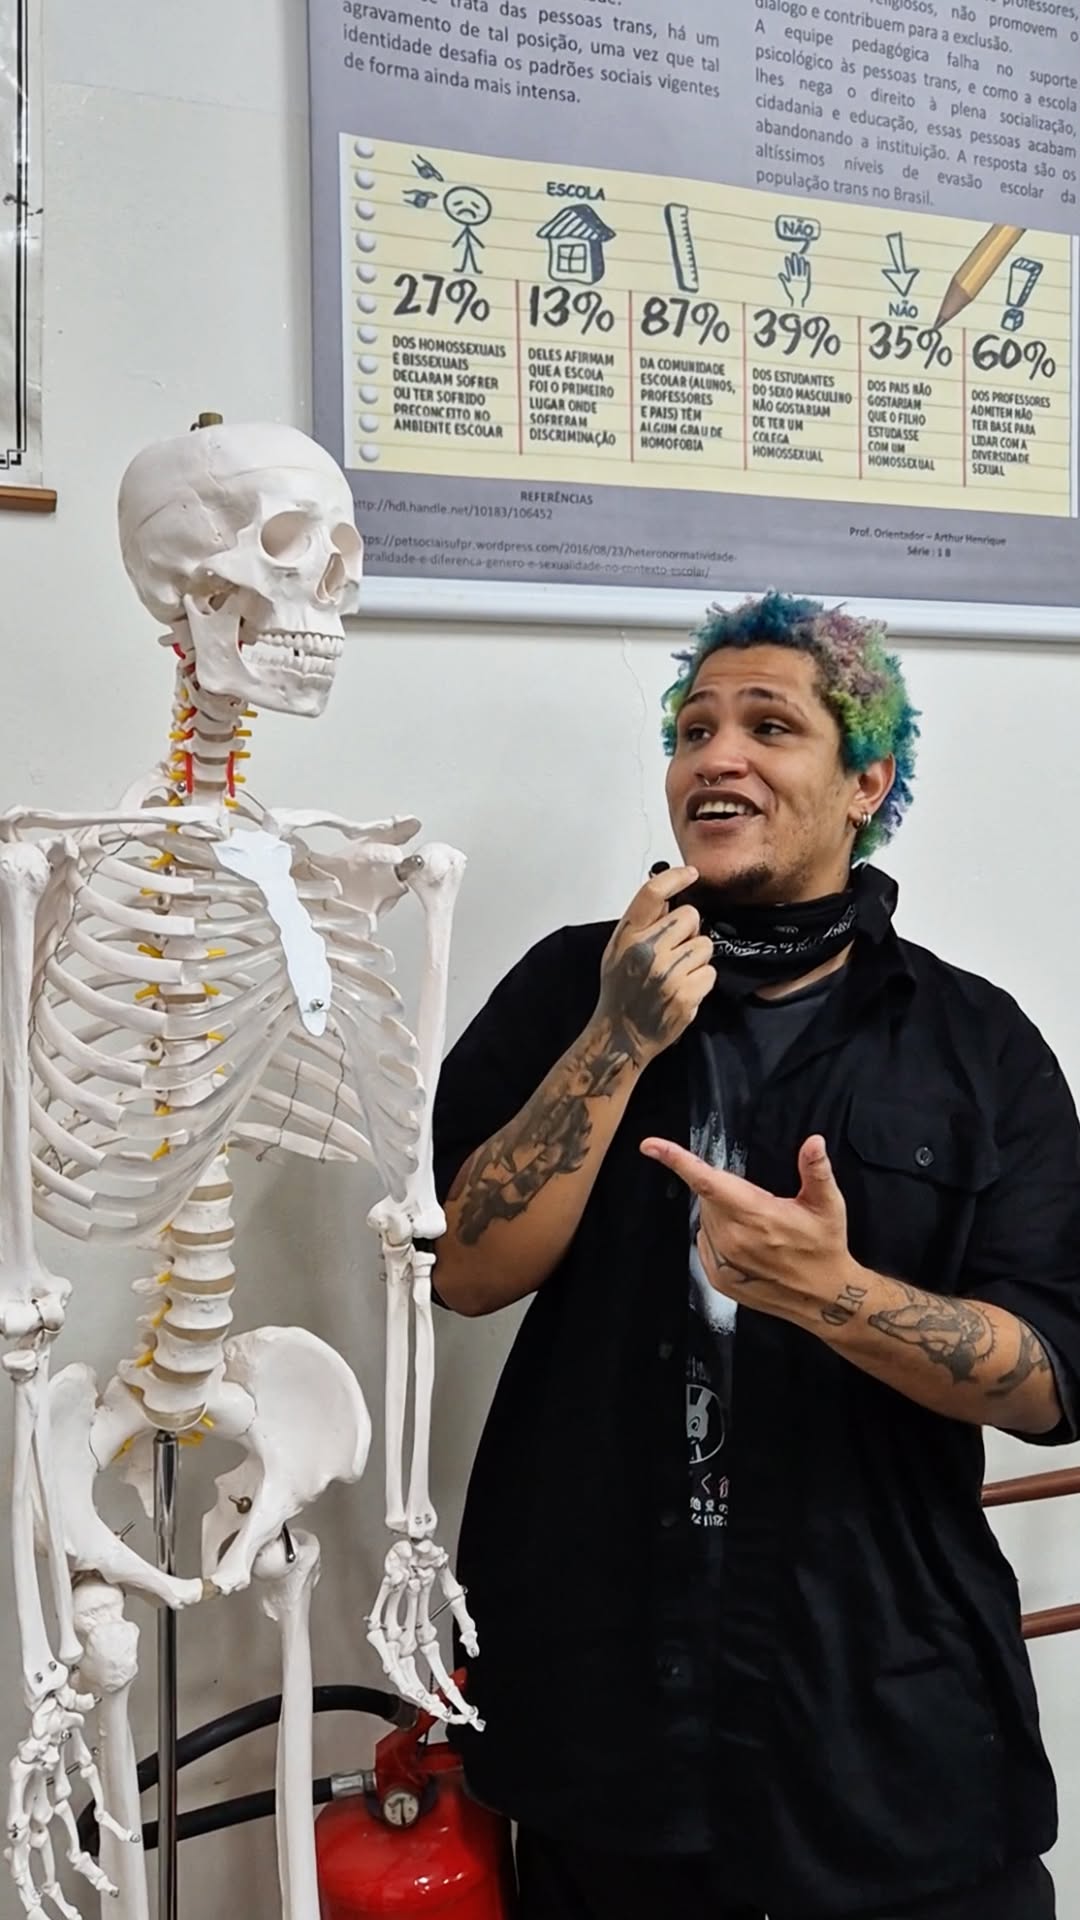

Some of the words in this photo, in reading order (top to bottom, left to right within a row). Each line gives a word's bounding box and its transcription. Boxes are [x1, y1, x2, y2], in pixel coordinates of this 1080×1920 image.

[499, 0, 527, 19] das
[538, 9, 603, 29] pessoas
[613, 16, 657, 39] trans,
[668, 22, 686, 41] há
[696, 31, 720, 48] um
[824, 9, 905, 33] contribuem
[908, 23, 938, 40] para
[953, 31, 1013, 53] exclusão.
[951, 5, 976, 23] não
[989, 14, 1058, 39] promovem
[343, 0, 451, 33] agravamento
[460, 20, 480, 38] de
[488, 25, 509, 43] tal
[517, 31, 582, 55] posição,
[591, 40, 625, 58] uma
[633, 47, 659, 62] vez
[666, 52, 694, 68] que
[702, 56, 720, 73] tal
[343, 24, 432, 56] identidade
[439, 43, 497, 67] desafia
[504, 57, 522, 71] os
[529, 58, 594, 79] padrões
[600, 68, 653, 87] sociais
[658, 74, 720, 98] vigentes
[755, 18, 766, 34] A
[784, 26, 834, 47] equipe
[852, 38, 929, 63] pedagógica
[947, 51, 980, 71] falha
[996, 63, 1014, 78] no
[1029, 69, 1078, 89] suporte
[344, 52, 365, 71] de
[369, 56, 420, 81] forma
[424, 68, 470, 89] ainda
[474, 77, 512, 96] mais
[516, 81, 581, 103] intensa.
[755, 45, 833, 71] psicológico
[841, 57, 856, 74] às
[863, 64, 917, 84] pessoas
[924, 73, 961, 94] trans,
[983, 84, 1018, 102] como
[1038, 95, 1077, 113] escola
[755, 67, 785, 87] lhes
[799, 78, 833, 97] nega
[870, 87, 916, 108] direito
[951, 100, 987, 120] plena
[999, 111, 1077, 138] socialização,
[755, 93, 823, 118] cidadania
[850, 110, 918, 134] educação,
[927, 122, 963, 139] essas
[970, 130, 1021, 149] pessoas
[1028, 139, 1077, 159] acabam
[755, 118, 854, 146] abandonando
[877, 136, 950, 161] instituição.
[957, 149, 967, 163] A
[974, 154, 1028, 173] resposta
[1034, 161, 1056, 178] são
[1062, 169, 1077, 182] os
[755, 142, 825, 167] altíssimos
[844, 157, 884, 175] níveis
[902, 164, 919, 180] de
[937, 171, 983, 189] evasão
[1000, 181, 1044, 199] escolar
[1060, 190, 1076, 205] da
[546, 181, 605, 201] ESCOLA
[756, 169, 830, 192] população
[833, 179, 869, 197] trans
[872, 186, 890, 199] no
[894, 186, 934, 206] Brasil.
[783, 218, 814, 237] NÃO
[393, 273, 490, 325] 27%
[529, 285, 614, 335] 13%
[888, 301, 919, 319] NÃO
[641, 296, 730, 346] 87%
[753, 308, 841, 359] 39%
[392, 334, 416, 350] DOS
[419, 337, 507, 358] HOMOSSEXUAIS
[868, 321, 953, 370] 35%
[402, 354, 469, 371] BISSEXUAIS
[528, 347, 562, 362] DELES
[564, 349, 615, 367] AFIRMAM
[639, 356, 655, 370] DA
[657, 358, 725, 376] COMUNIDADE
[972, 334, 1056, 380] 60%
[393, 369, 453, 386] DECLARAM
[456, 375, 499, 390] SOFRER
[528, 363, 551, 378] QUE
[564, 366, 604, 382] ESCOLA
[752, 367, 772, 382] DOS
[774, 370, 835, 388] ESTUDANTES
[529, 380, 548, 393] FOI
[562, 382, 614, 399] PRIMEIRO
[640, 373, 687, 388] ESCOLAR
[688, 375, 736, 395] (ALUNOS,
[752, 383, 767, 396] DO
[769, 385, 793, 399] SEXO
[795, 388, 853, 405] MASCULINO
[867, 379, 887, 393] DOS
[889, 381, 910, 395] PAIS
[912, 382, 932, 397] NÃO
[393, 386, 411, 400] OU
[412, 387, 434, 402] TER
[437, 389, 486, 406] SOFRIDO
[529, 397, 566, 412] LUGAR
[568, 399, 598, 414] ONDE
[640, 388, 714, 406] PROFESSORES
[867, 394, 922, 411] GOSTARIAM
[971, 389, 990, 402] DOS
[991, 391, 1051, 409] PROFESSORES
[393, 403, 471, 421] PRECONCEITO
[474, 409, 491, 422] NO
[640, 405, 647, 418] E
[650, 406, 679, 422] PAIS)
[680, 407, 702, 422] TÊM
[752, 398, 774, 413] NÃO
[775, 401, 831, 418] GOSTARIAM
[867, 409, 887, 424] QUE
[898, 413, 926, 426] FILHO
[971, 404, 1013, 419] ADMITEM
[1014, 407, 1033, 421] NÃO
[394, 418, 451, 435] AMBIENTE
[454, 422, 503, 438] ESCOLAR
[529, 412, 588, 428] SOFRERAM
[640, 421, 677, 435] ALGUM
[680, 424, 708, 437] GRAU
[710, 426, 723, 439] DE
[752, 415, 765, 429] DE
[767, 417, 786, 430] TER
[788, 419, 804, 432] UM
[971, 419, 988, 432] TER
[990, 420, 1013, 434] BASE
[1014, 423, 1036, 436] PARA
[529, 427, 617, 448] DISCRIMINAÇÃO
[640, 436, 704, 451] HOMOFOBIA
[752, 431, 790, 444] COLEGA
[868, 425, 920, 442] ESTUDASSE
[971, 435, 998, 448] LIDAR
[1000, 436, 1020, 449] COM
[752, 445, 824, 463] HOMOSSEXUAL
[868, 440, 889, 453] COM
[891, 442, 906, 454] UM
[971, 449, 1030, 464] DIVERSIDADE
[868, 454, 936, 471] HOMOSSEXUAL
[972, 463, 1005, 477] SEXUAL
[520, 491, 593, 505] REFERÊNCIAS
[849, 526, 872, 538] Prof.
[874, 528, 925, 541] Orientador
[933, 532, 964, 544] Arthur
[965, 534, 1007, 546] Henrique
[907, 545, 929, 556] Série
